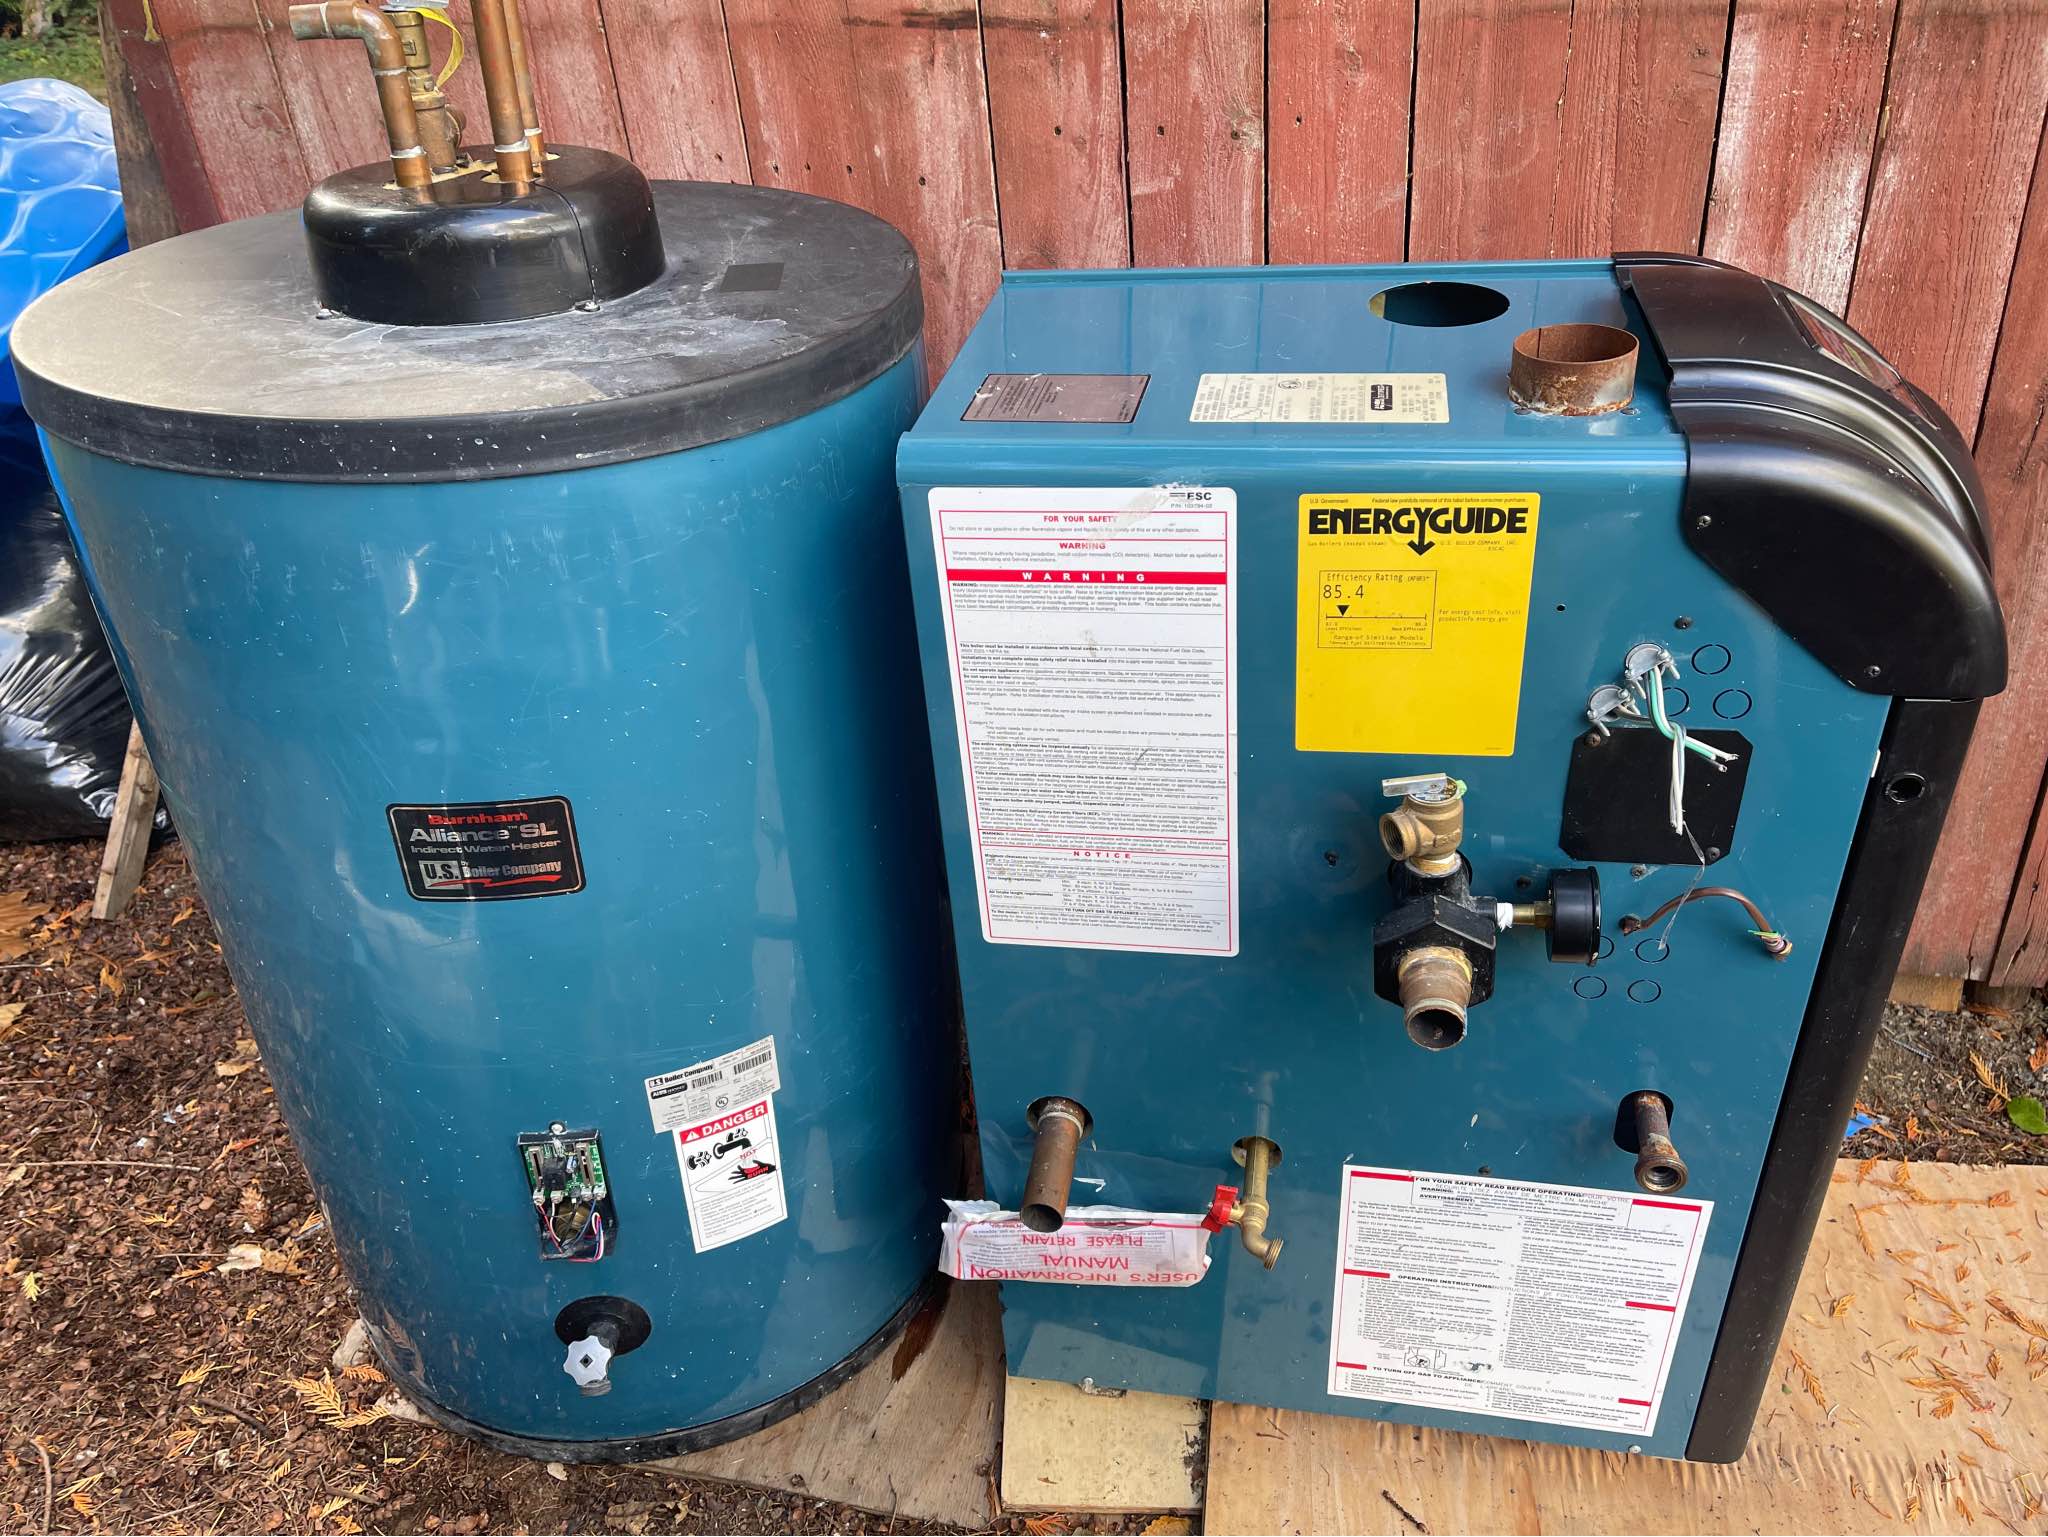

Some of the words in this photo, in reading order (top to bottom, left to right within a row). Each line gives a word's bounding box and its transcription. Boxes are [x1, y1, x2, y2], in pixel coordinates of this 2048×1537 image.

[1309, 508, 1528, 540] ENERGYGUIDE
[1022, 572, 1144, 581] WARNING
[1327, 574, 1372, 584] Efficiency
[1376, 573, 1403, 582] Rating
[1323, 584, 1364, 598] 85.4
[428, 812, 528, 825] Burnham
[520, 822, 558, 838] SL
[411, 845, 462, 854] Indirect
[463, 844, 510, 853] Water
[511, 839, 561, 850] Heater
[423, 863, 460, 880] U.S.
[462, 865, 500, 878] Boiler
[502, 861, 562, 876] Company
[664, 1073, 683, 1083] Boiler
[684, 1064, 713, 1077] Company
[702, 1105, 765, 1136] DANGER
[1022, 1234, 1075, 1247] RETAIN
[1087, 1235, 1143, 1247] PLEASE
[1039, 1254, 1128, 1270] MANUAL
[970, 1264, 1116, 1281] INFORMATION
[1130, 1272, 1200, 1283] USER'S
[1398, 1275, 1438, 1283] OPERATING
